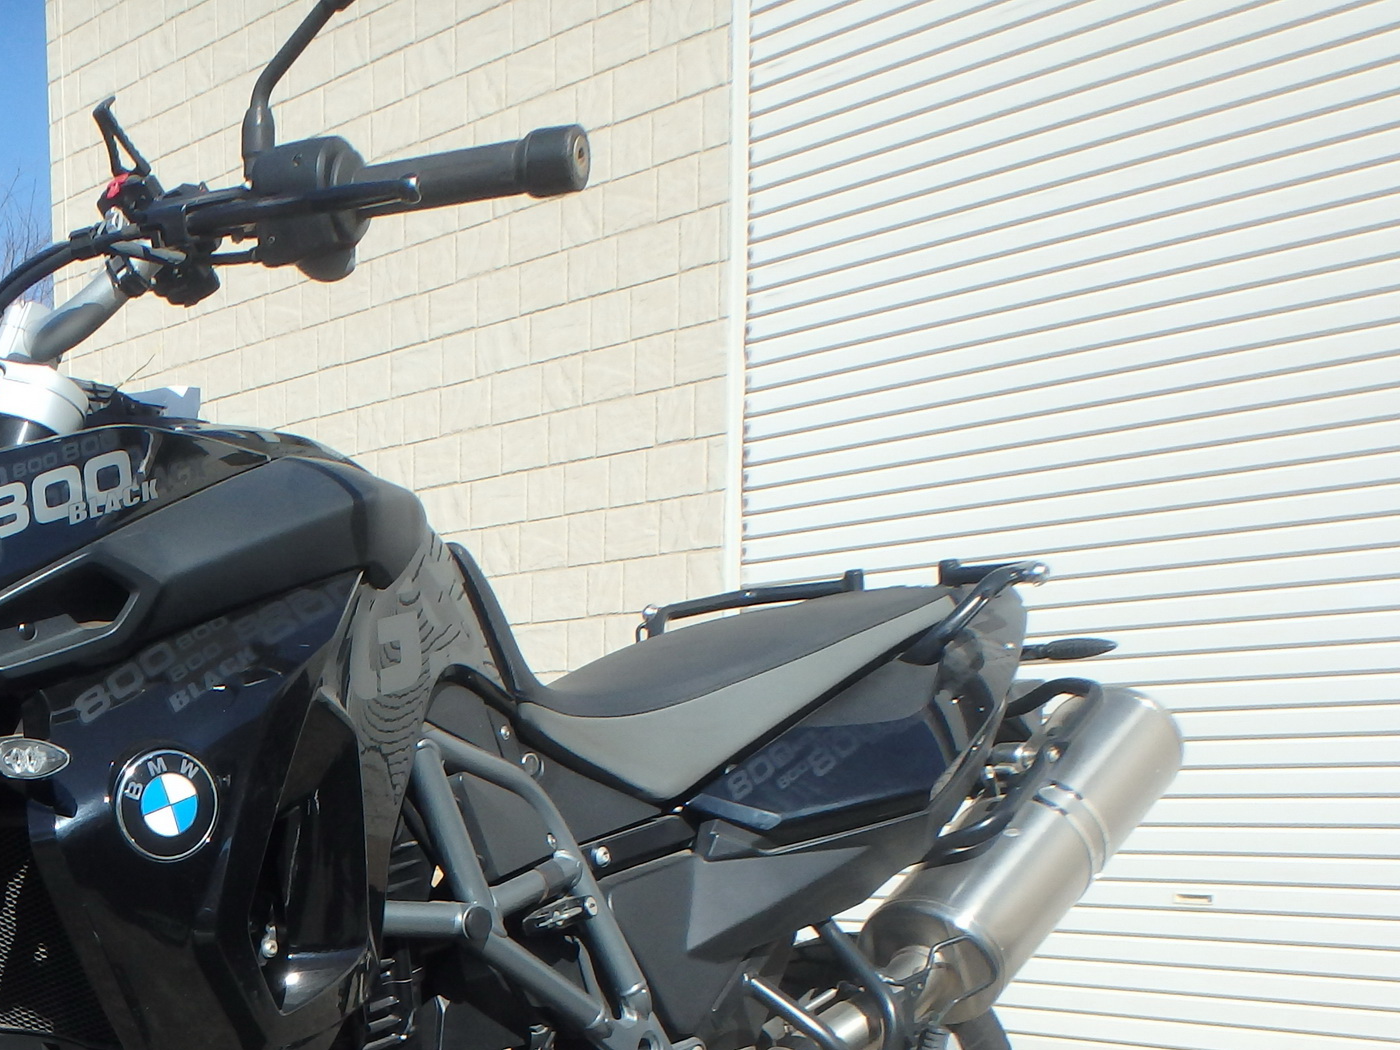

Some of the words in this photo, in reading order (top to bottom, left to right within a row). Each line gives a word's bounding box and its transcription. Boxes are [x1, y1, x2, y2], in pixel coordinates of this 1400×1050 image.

[67, 478, 159, 525] BLACK
[74, 641, 177, 724] 800
[166, 646, 260, 714] BLACK
[124, 755, 200, 802] BMW
